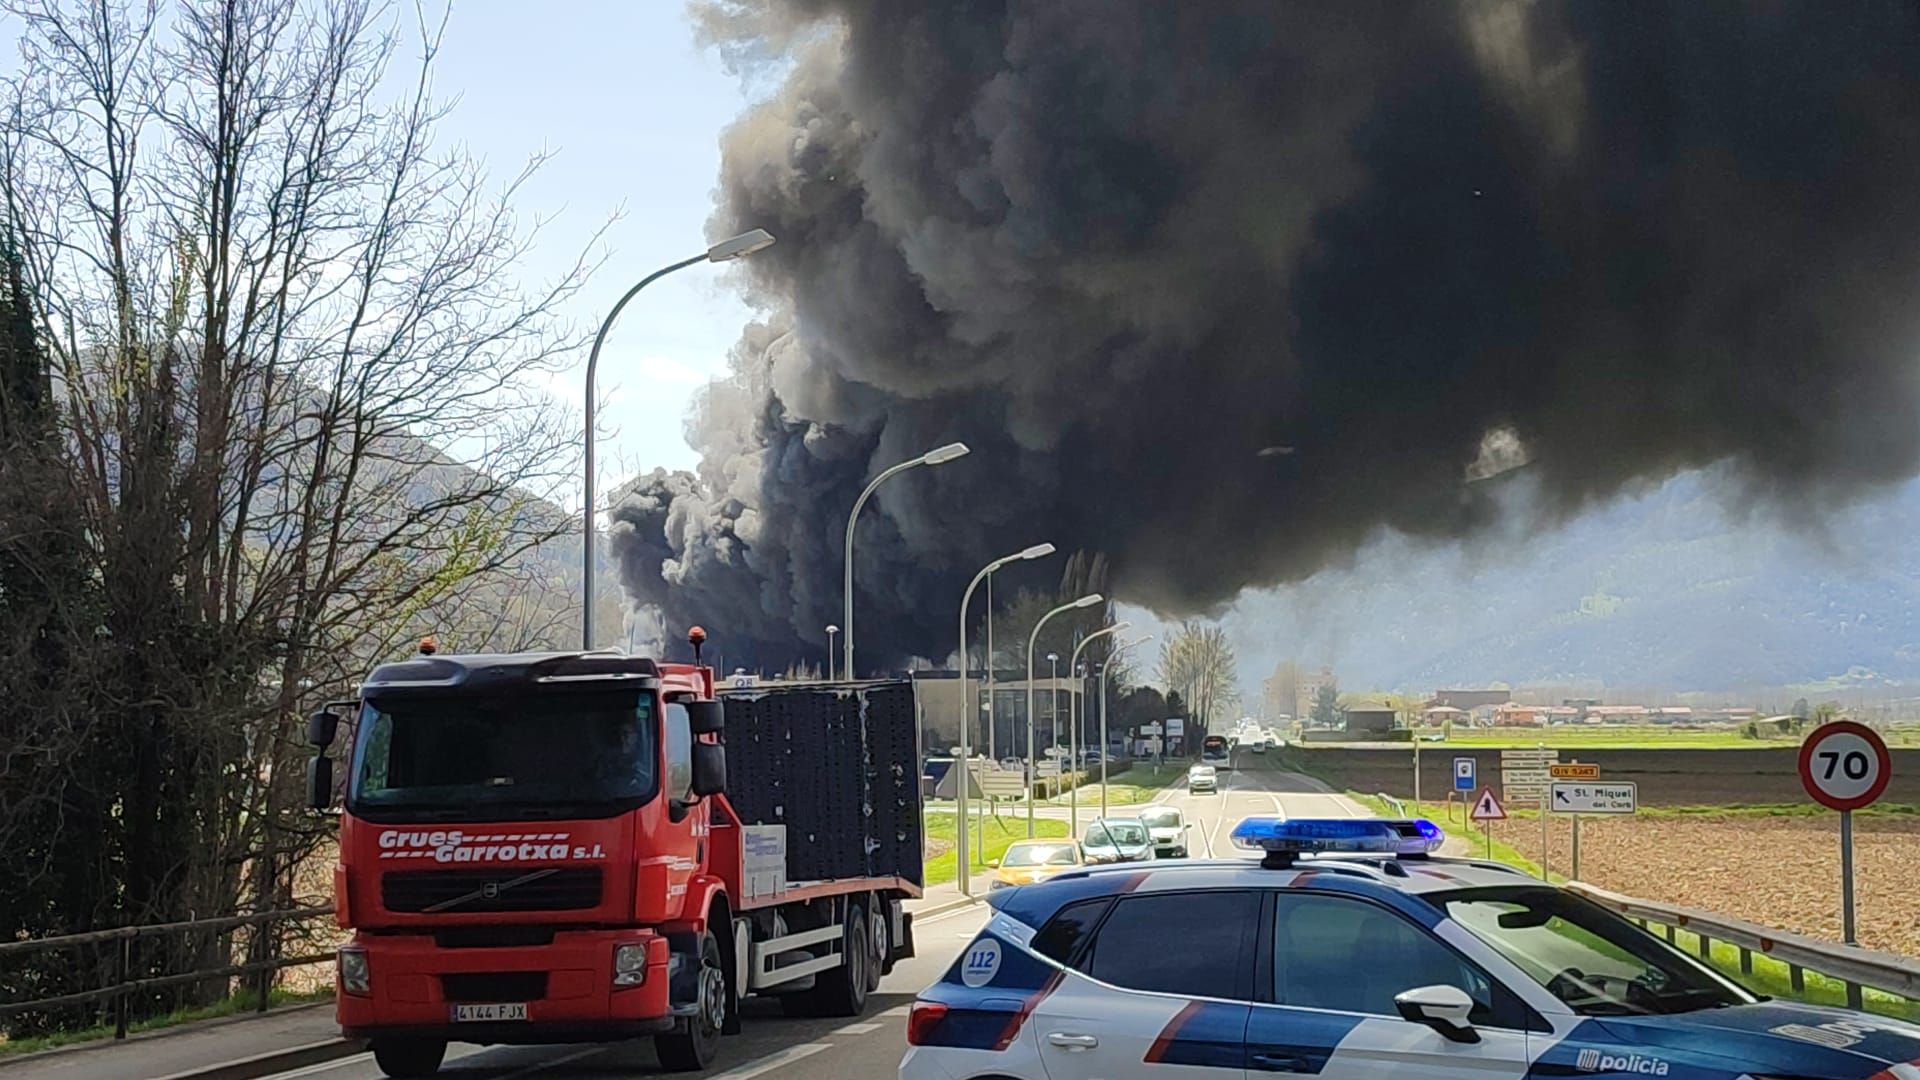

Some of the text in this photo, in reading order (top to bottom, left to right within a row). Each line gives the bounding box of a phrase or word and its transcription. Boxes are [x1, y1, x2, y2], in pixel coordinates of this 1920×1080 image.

[1819, 751, 1868, 780] 70
[1595, 788, 1632, 800] Miquel
[378, 831, 463, 847] Grues
[435, 843, 606, 862] Garrotxa s.l.
[969, 952, 995, 967] 112
[460, 1005, 524, 1019] 4144 FJX
[1599, 1053, 1669, 1076] policia
